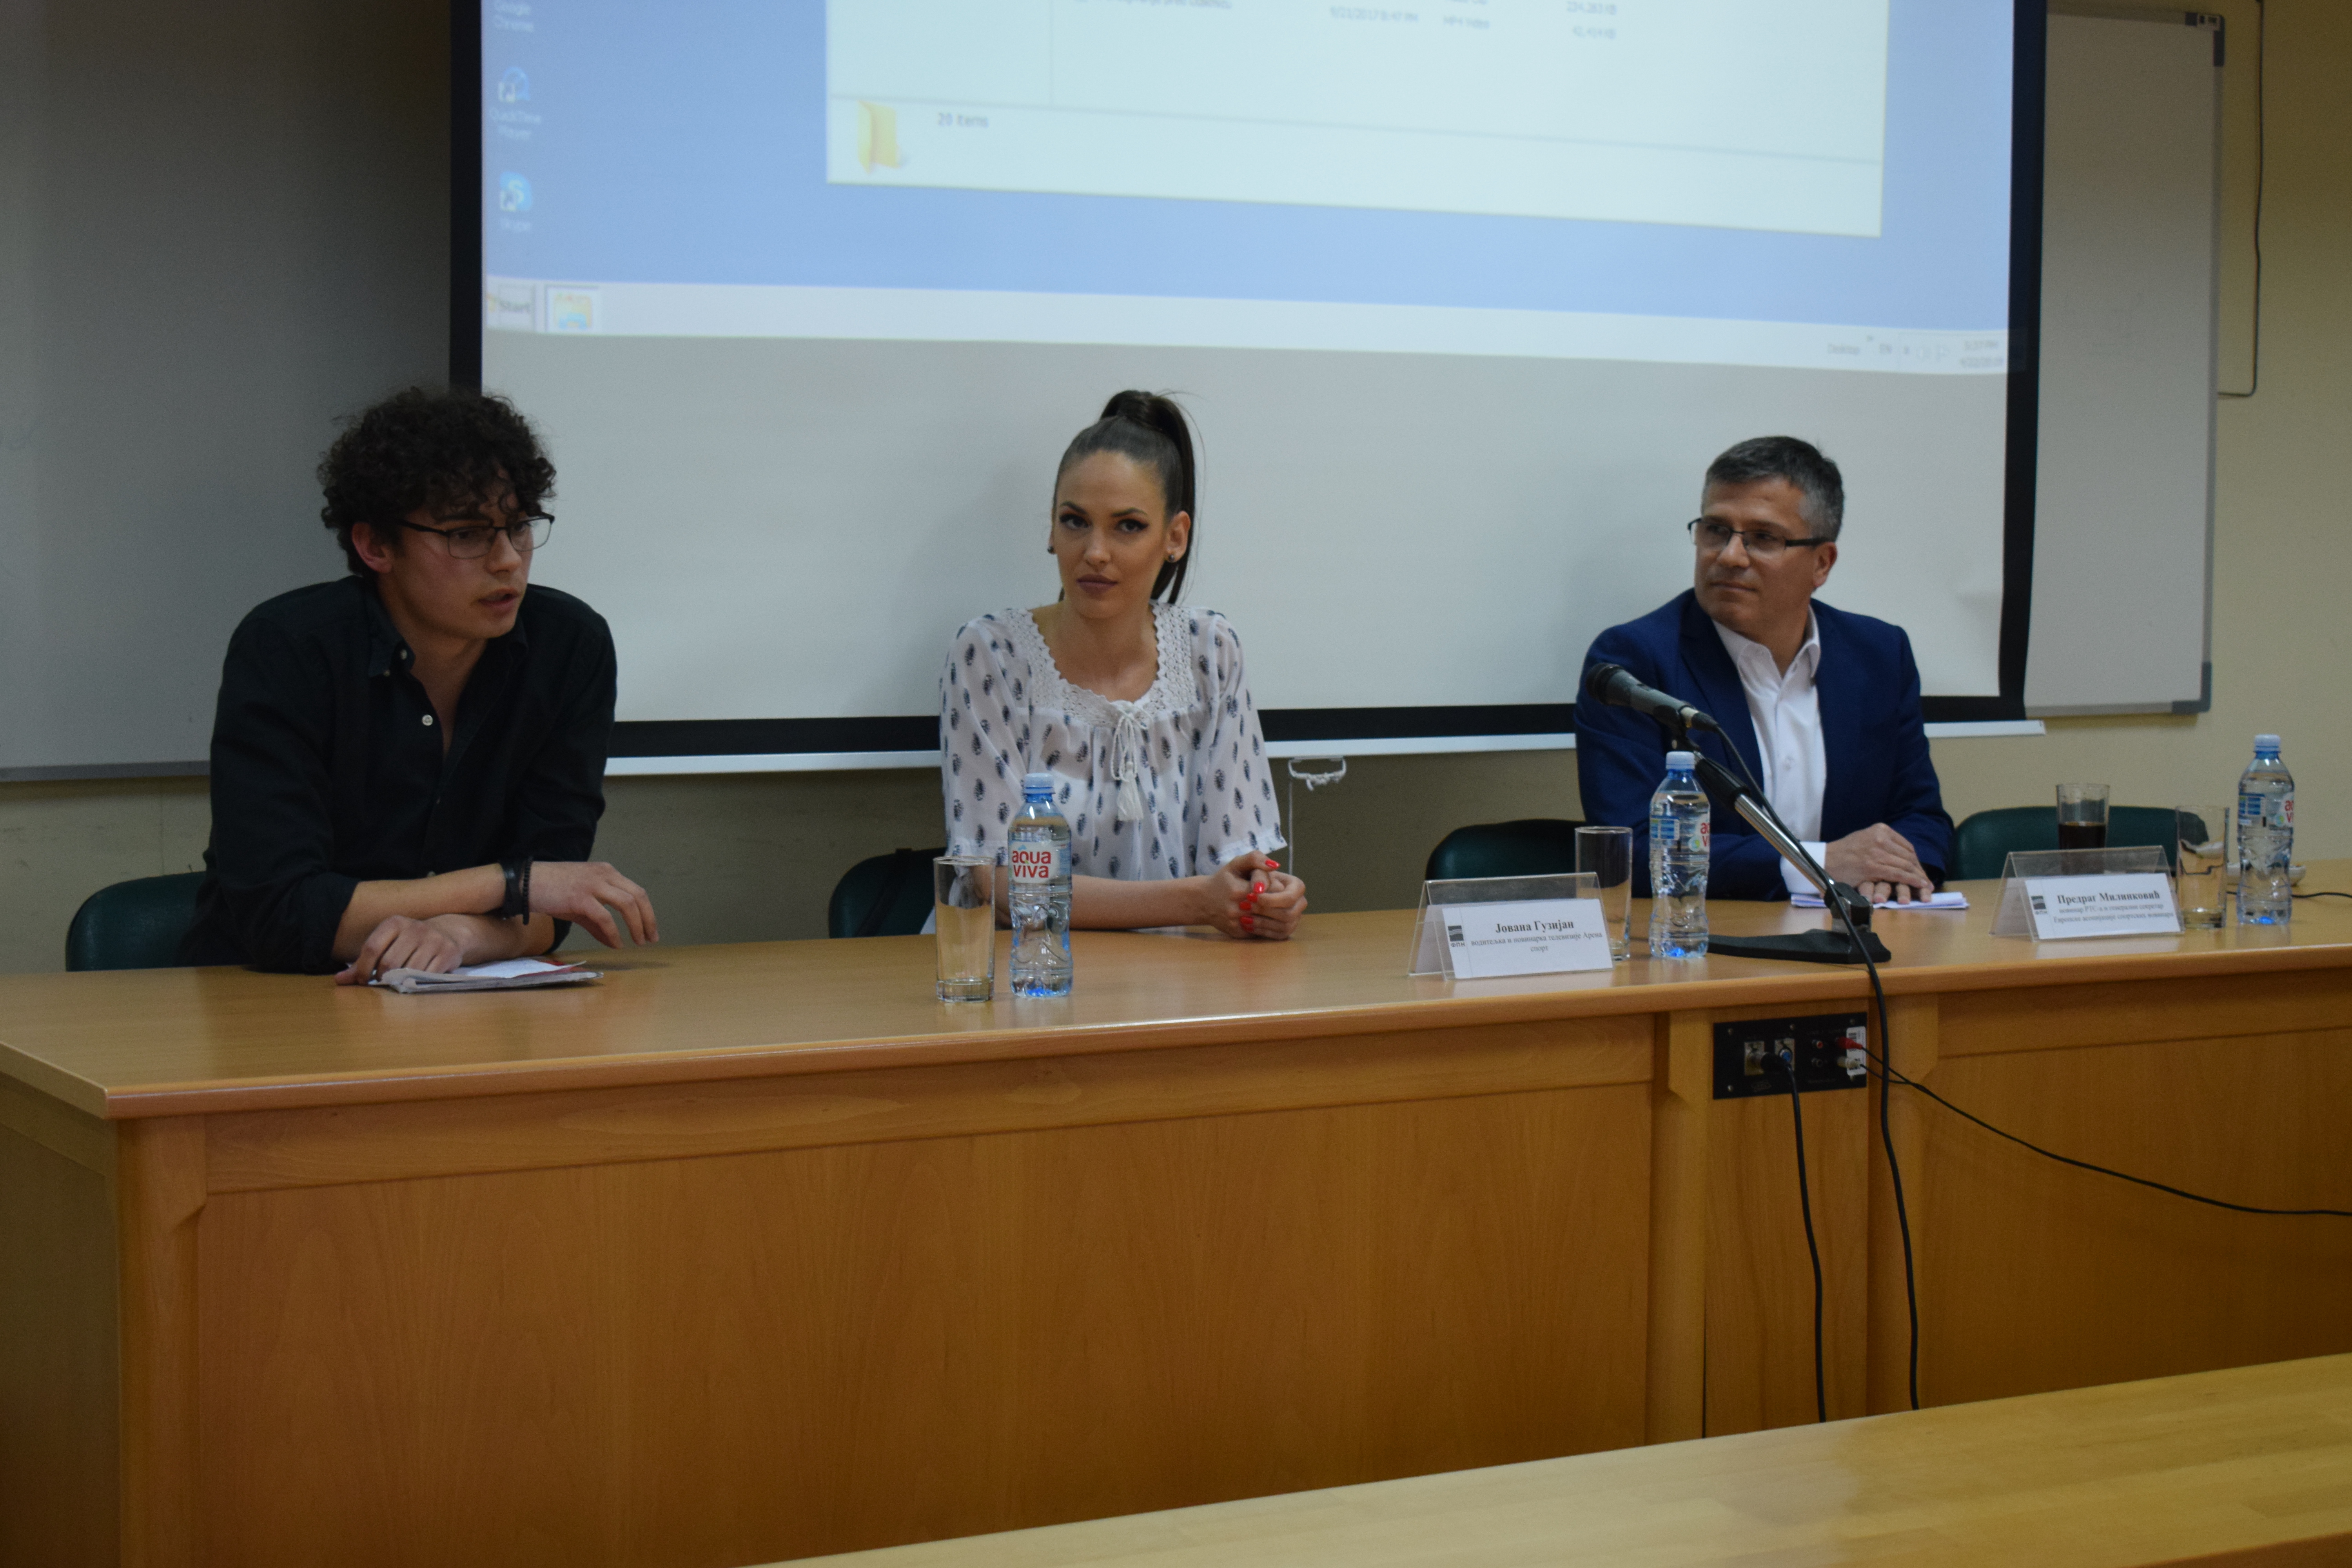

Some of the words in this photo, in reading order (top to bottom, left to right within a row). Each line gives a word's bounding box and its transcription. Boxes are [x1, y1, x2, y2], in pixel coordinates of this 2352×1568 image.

[1012, 851, 1051, 864] aqua
[1013, 865, 1049, 878] viva
[2057, 895, 2096, 906] Предраг
[2099, 890, 2160, 901] Милинковић
[1496, 923, 1532, 933] Јована
[1534, 920, 1574, 933] Гузијан
[1514, 935, 1547, 943] новинарка
[1548, 932, 1581, 941] телевизије
[1583, 931, 1602, 940] Арена
